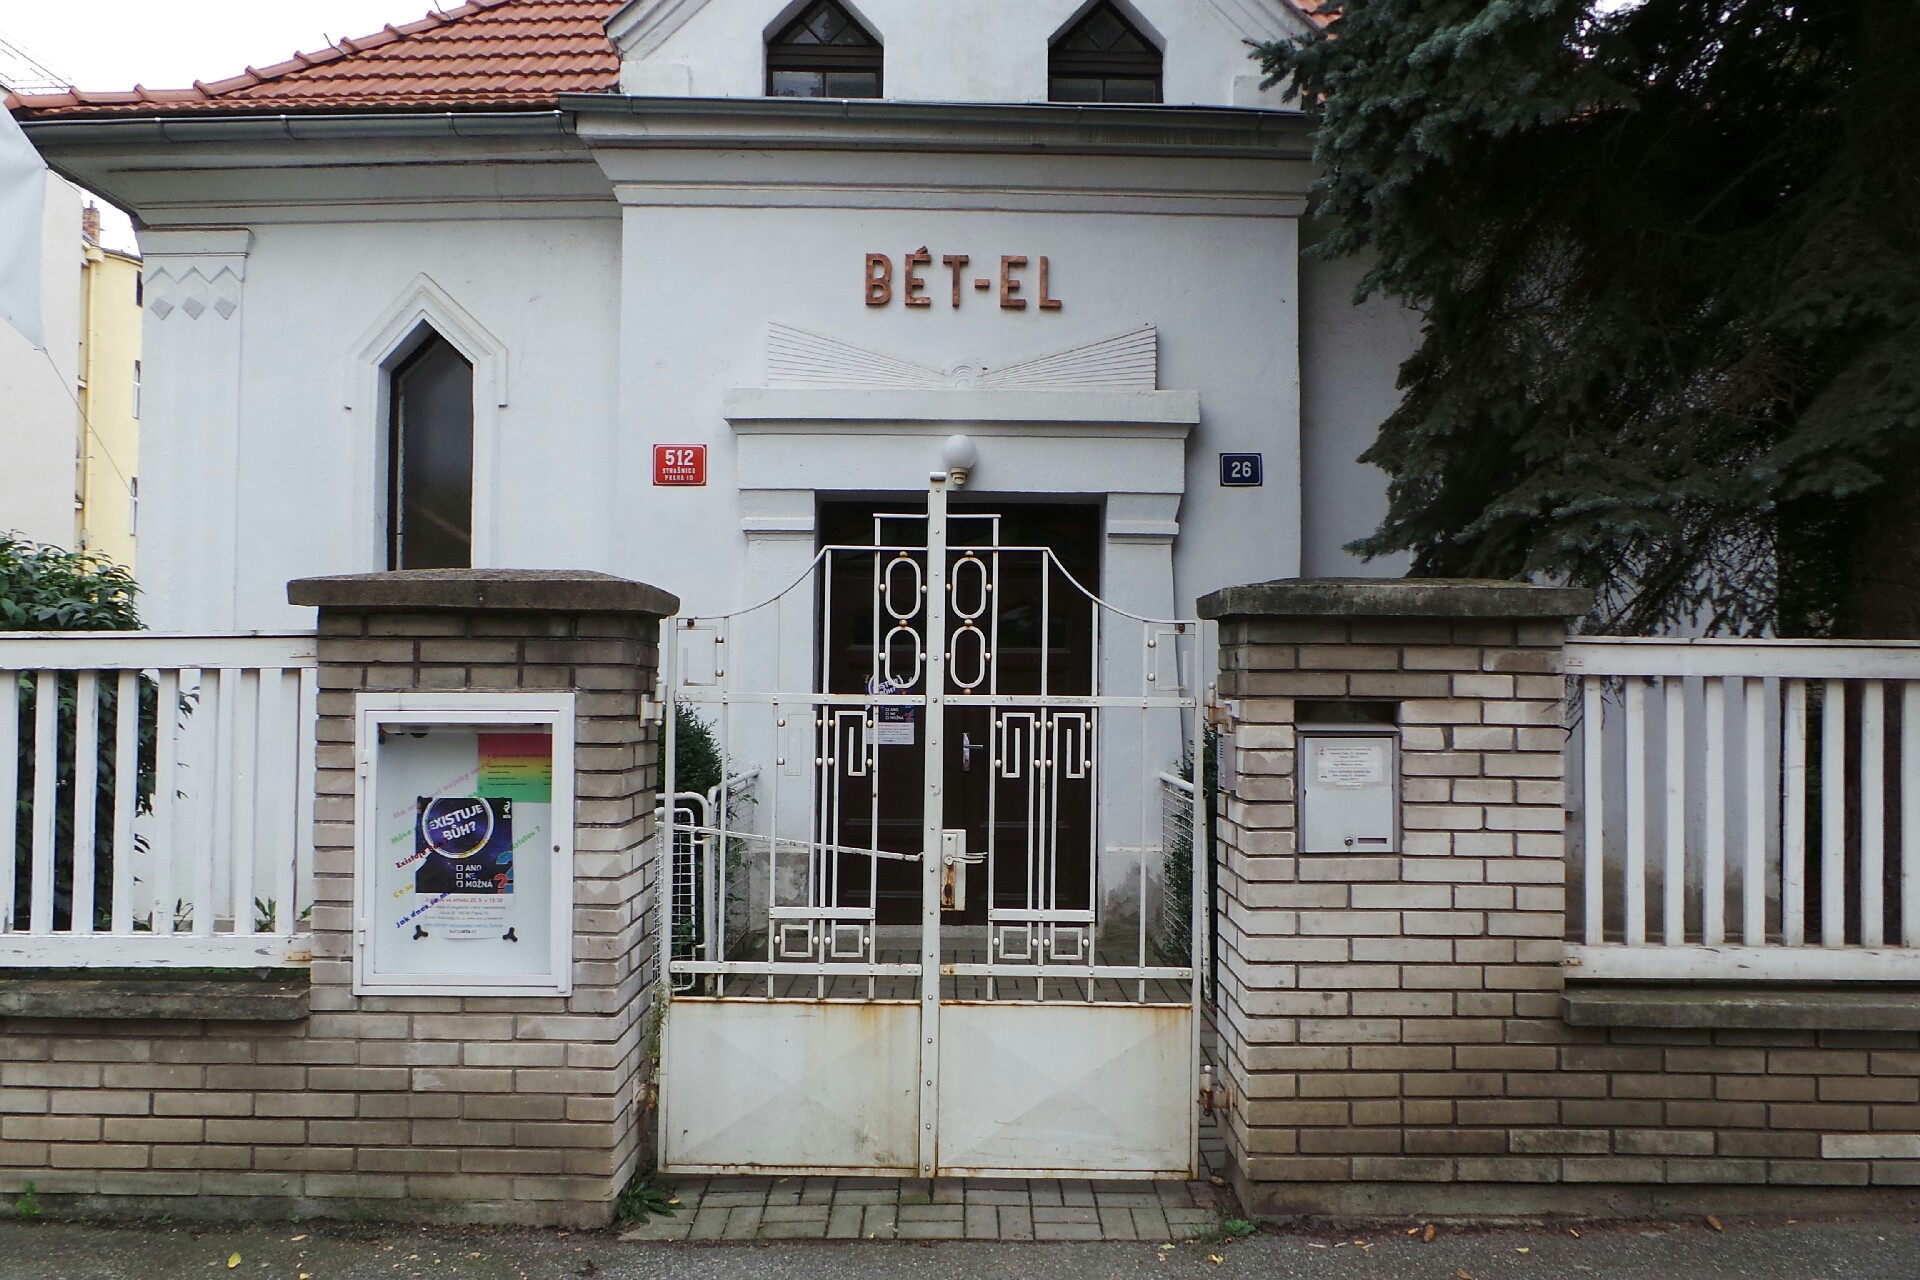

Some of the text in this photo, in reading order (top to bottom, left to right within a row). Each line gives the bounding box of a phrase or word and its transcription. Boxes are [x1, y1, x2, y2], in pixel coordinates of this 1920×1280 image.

[866, 246, 1063, 309] BÉT-EL
[665, 449, 694, 465] 512
[662, 466, 696, 474] STRAŠNICE
[1231, 461, 1252, 478] 26
[429, 804, 484, 830] EXISTUJE
[442, 821, 477, 841] BŮH?
[465, 879, 493, 888] MOŽNÁ
[396, 915, 411, 928] Jak
